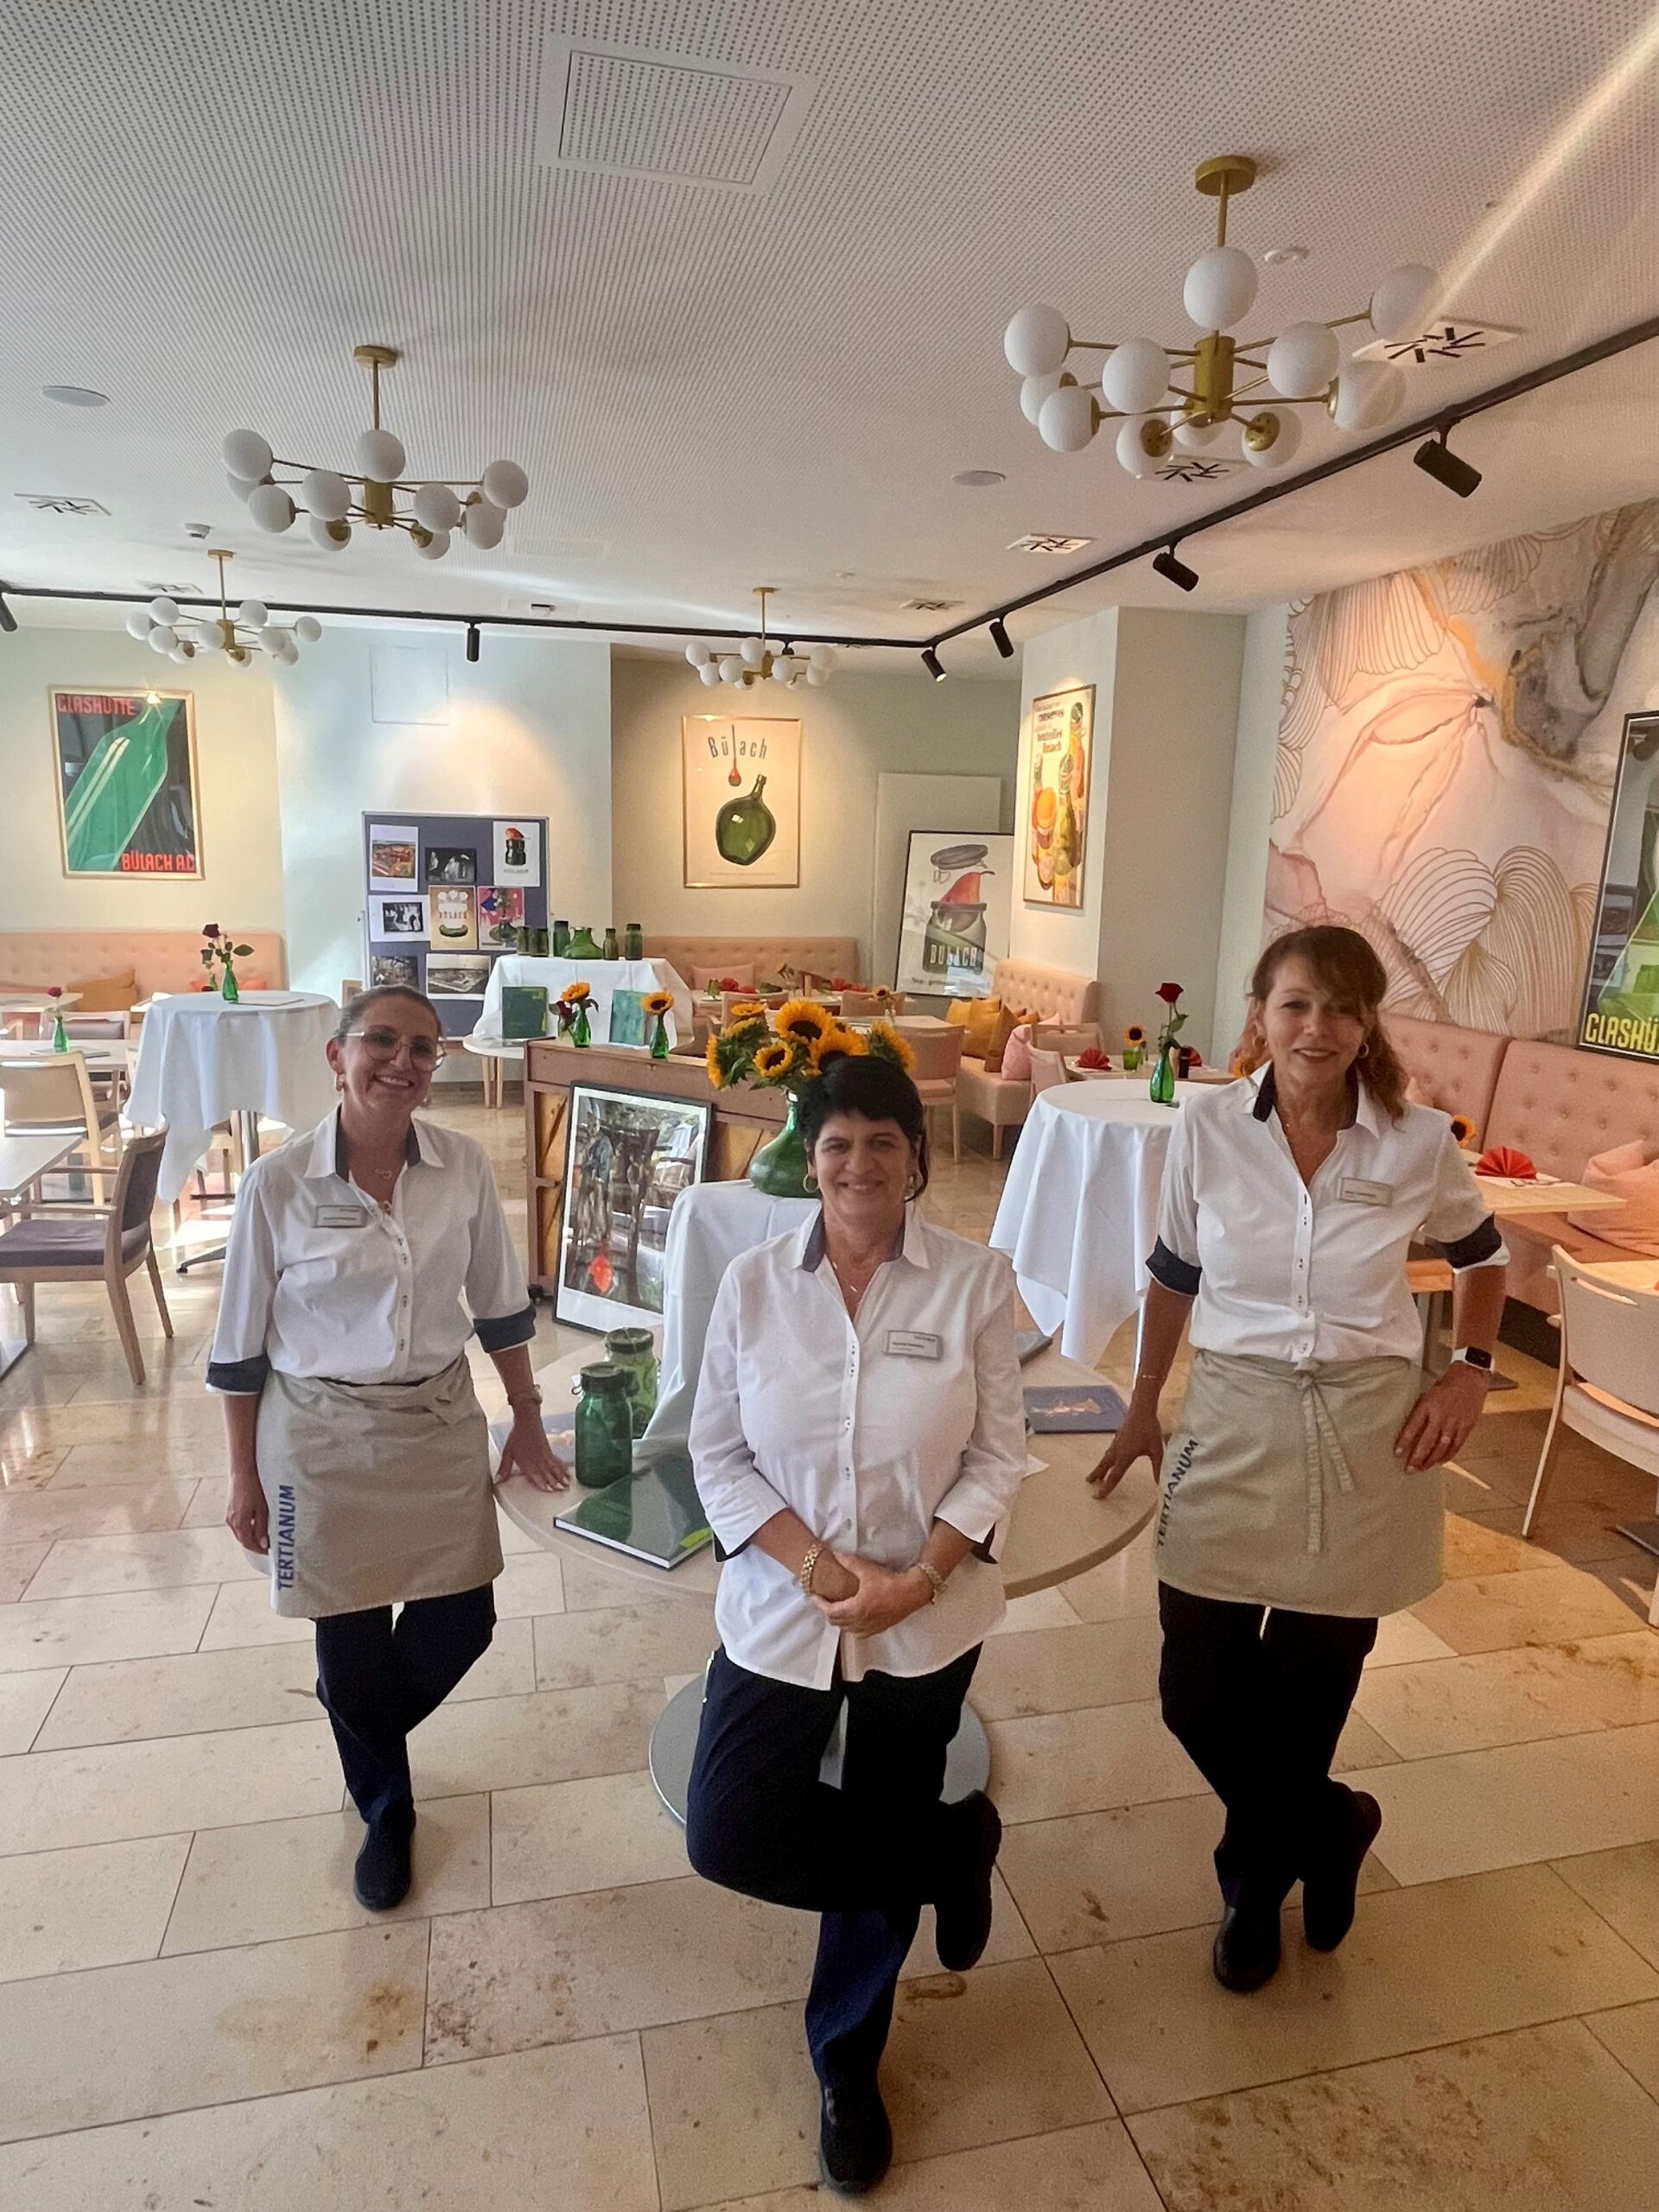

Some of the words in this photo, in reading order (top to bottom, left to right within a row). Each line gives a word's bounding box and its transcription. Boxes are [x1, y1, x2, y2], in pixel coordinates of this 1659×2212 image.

[708, 724, 767, 760] Bülach
[1585, 1013, 1659, 1054] GLASHÜ
[1157, 1439, 1198, 1548] TERTIANUM
[276, 1484, 296, 1591] TERTIANUM
